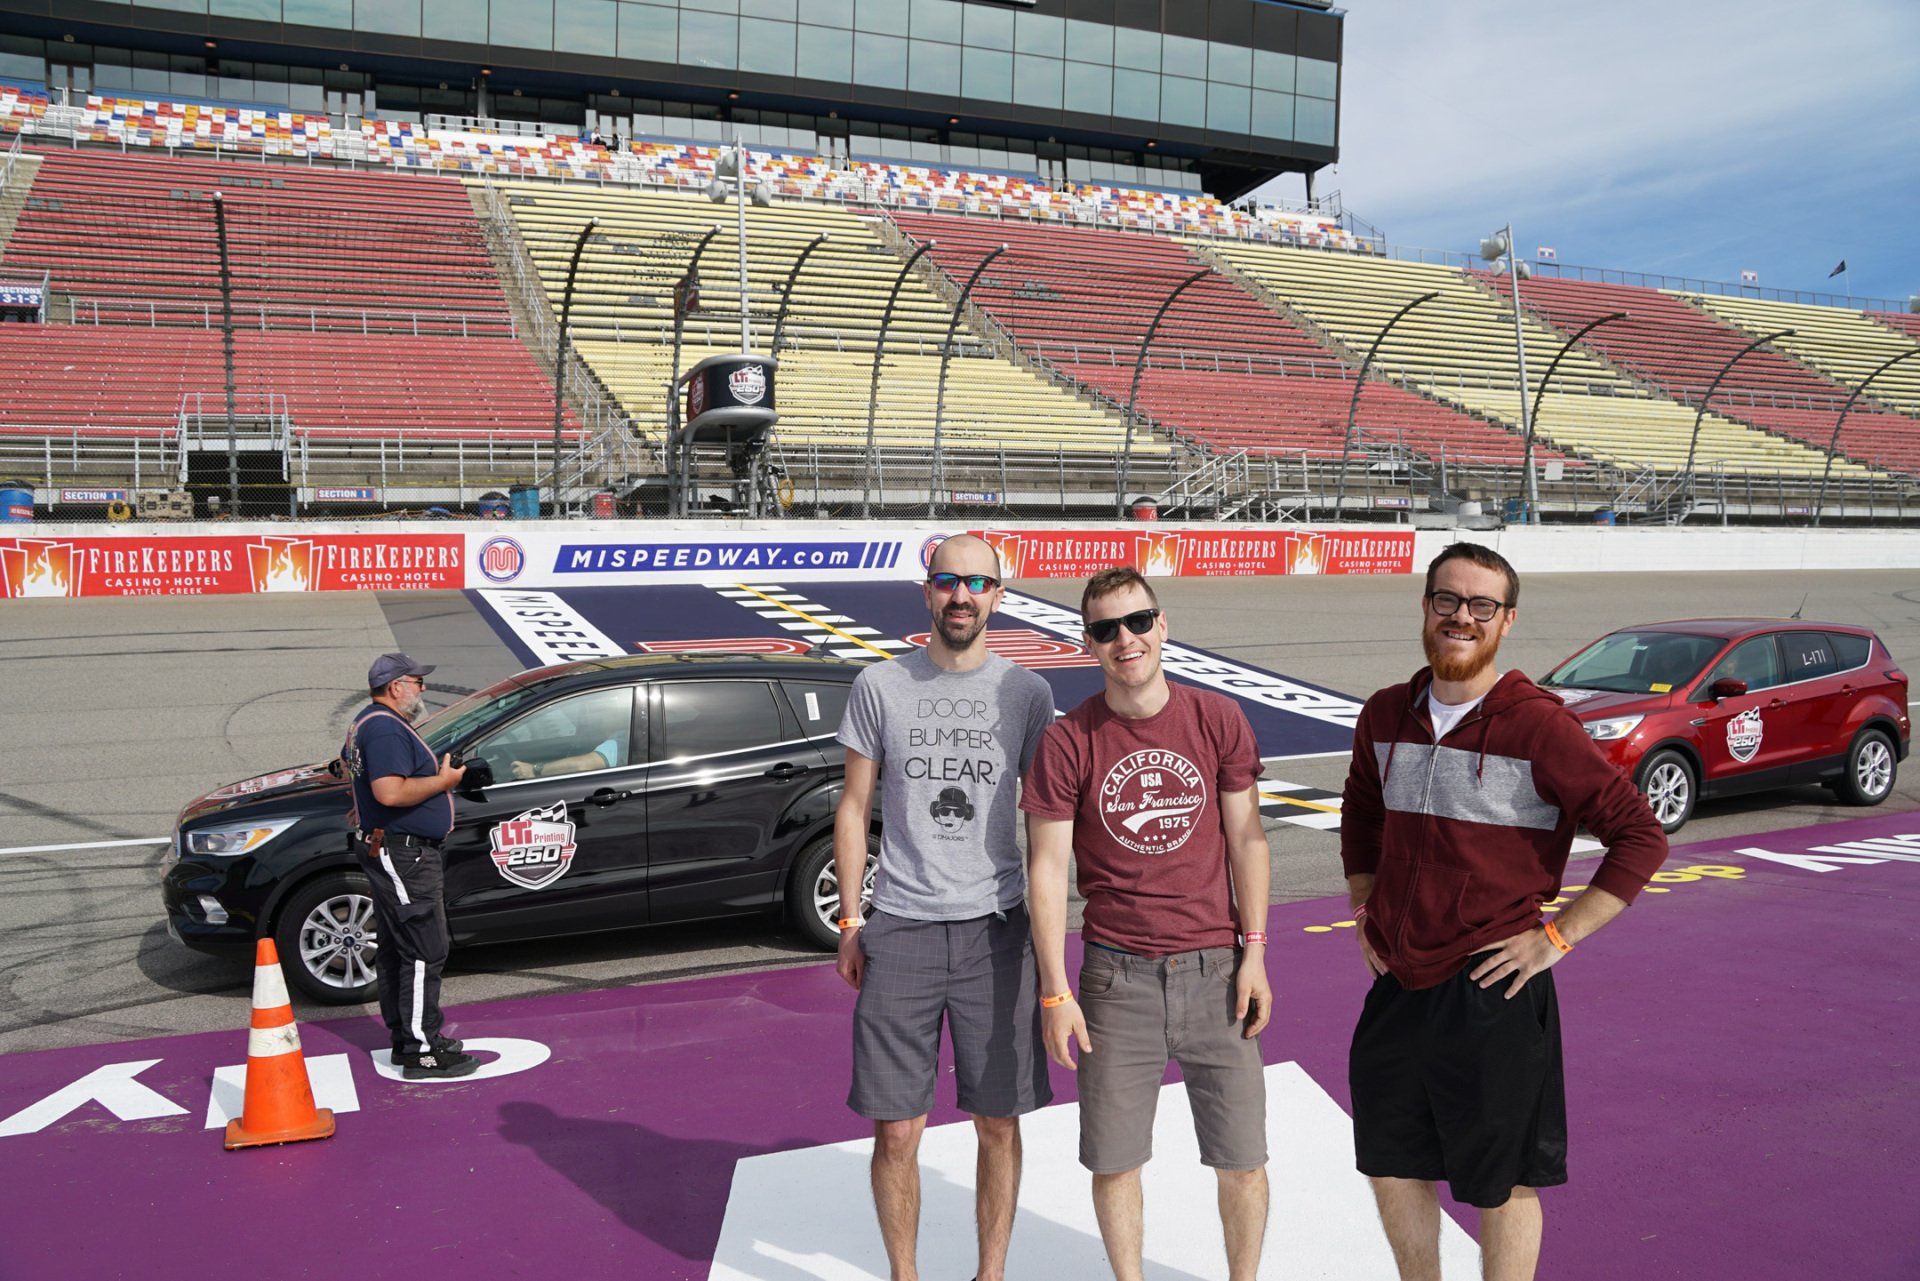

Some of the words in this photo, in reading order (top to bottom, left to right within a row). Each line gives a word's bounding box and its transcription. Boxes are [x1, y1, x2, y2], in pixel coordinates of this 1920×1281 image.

[64, 491, 107, 500] SECTION
[111, 492, 118, 500] 1
[318, 489, 357, 498] SECTION
[362, 490, 367, 498] 1
[571, 548, 850, 569] MISPEEDWAY.com
[1339, 560, 1371, 568] CASINO
[1376, 560, 1402, 568] HOTEL
[1039, 563, 1076, 571] CASINO
[1238, 561, 1266, 569] HOTEL
[105, 578, 161, 587] CASINO
[174, 577, 219, 586] HOTEL
[341, 574, 393, 582] CASINO
[404, 573, 446, 581] HOTEL
[123, 588, 161, 596] BATTLE
[170, 587, 203, 595] CREEK
[1104, 752, 1200, 796] CALIFORNIA
[1140, 772, 1163, 788] USA
[1105, 794, 1136, 813] San
[1138, 790, 1203, 810] Francisco
[1159, 816, 1190, 829] 1975
[501, 819, 533, 846] LTi
[534, 833, 566, 844] Printing
[1119, 835, 1164, 852] AUTHENTIC
[1167, 829, 1191, 849] BRAND
[507, 845, 561, 866] 250
